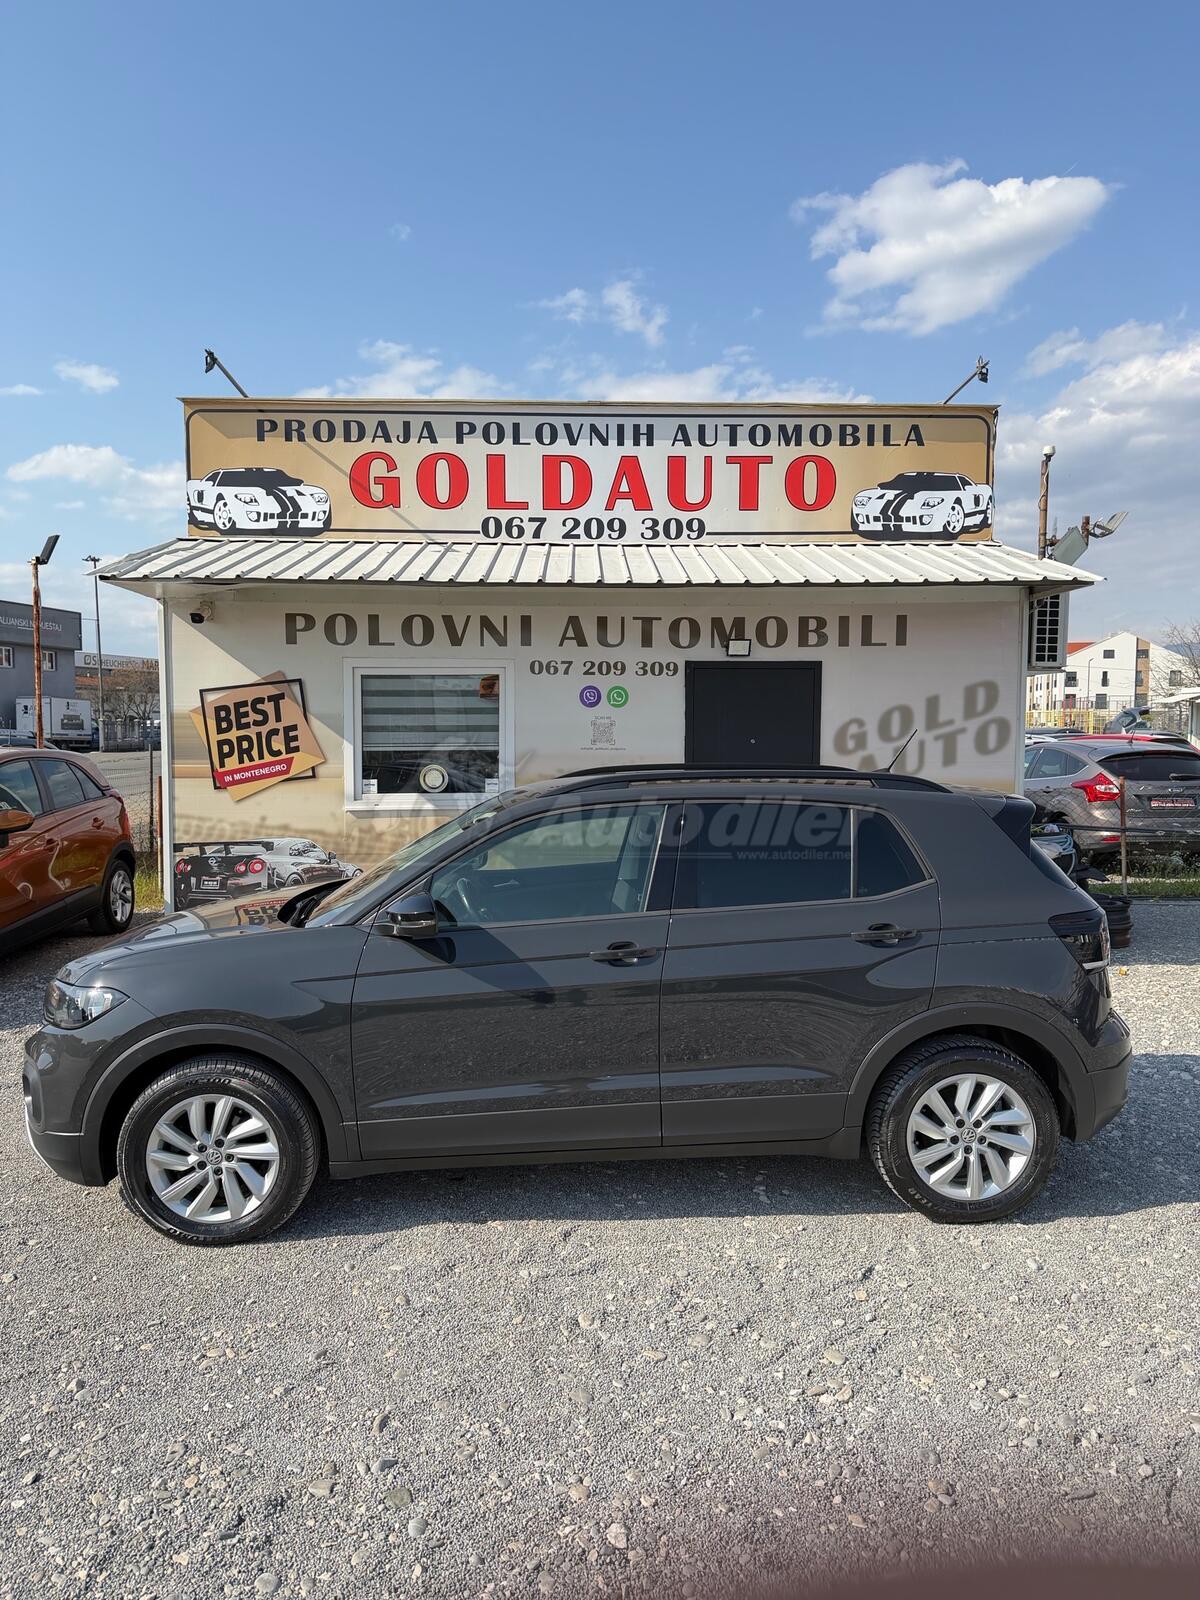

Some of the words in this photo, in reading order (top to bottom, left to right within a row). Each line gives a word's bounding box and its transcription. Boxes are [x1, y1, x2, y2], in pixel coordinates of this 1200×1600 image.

[256, 418, 439, 444] PRODAJA
[455, 420, 655, 447] POLOVNIH
[671, 423, 926, 447] AUTOMOBILA
[349, 451, 837, 512] GOLDAUTO
[479, 516, 547, 540] 067
[562, 516, 627, 541] 209
[641, 517, 707, 541] 309
[284, 612, 532, 648] POLOVNI
[557, 614, 910, 649] AUTOMOBILI
[529, 659, 578, 677] 067
[582, 660, 627, 677] 209
[635, 660, 679, 677] 309
[214, 692, 285, 736] BEST
[833, 679, 1000, 756] GOLD
[216, 724, 300, 769] PRICE
[224, 774, 233, 783] IN
[233, 763, 287, 780] MONTENEGRO
